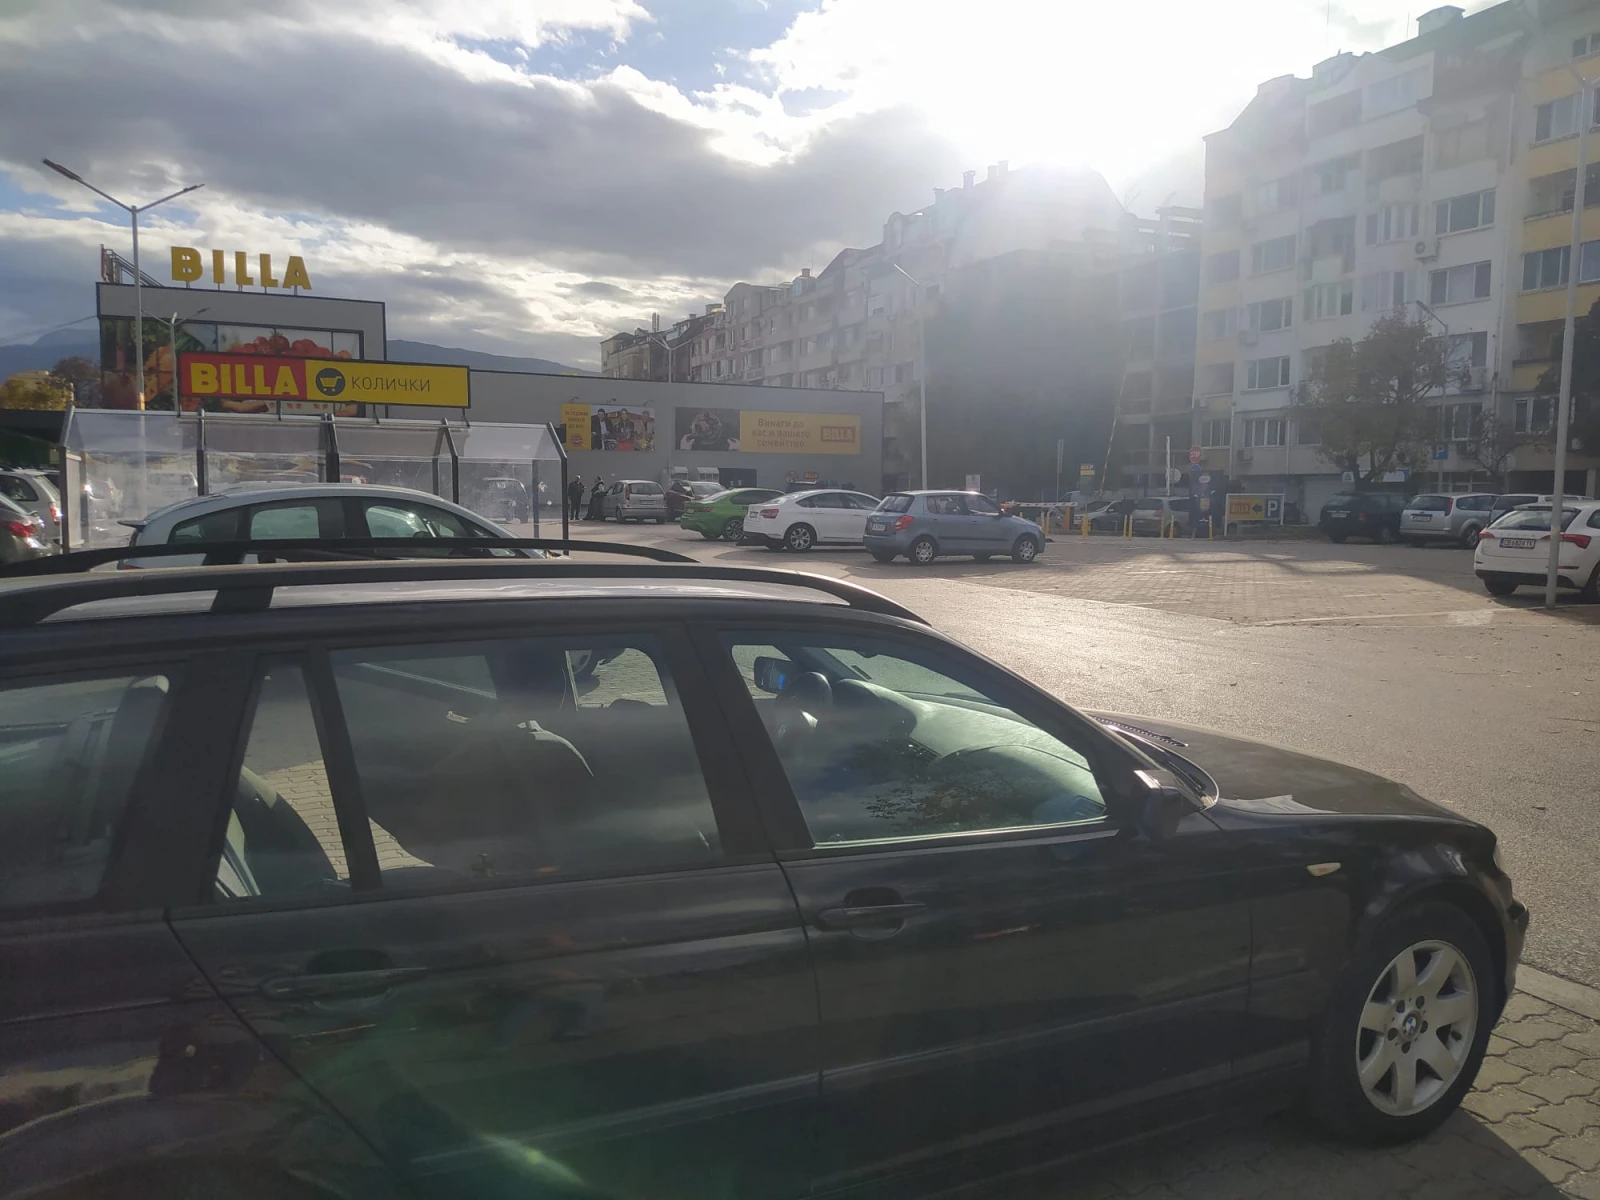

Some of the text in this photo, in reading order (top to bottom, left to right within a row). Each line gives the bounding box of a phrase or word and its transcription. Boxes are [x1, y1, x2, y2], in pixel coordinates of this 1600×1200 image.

[171, 246, 312, 290] BILLA
[190, 362, 299, 396] BILLA
[351, 376, 431, 393] КОЛИЧКИ
[822, 428, 854, 441] BILLA
[1267, 500, 1278, 517] P
